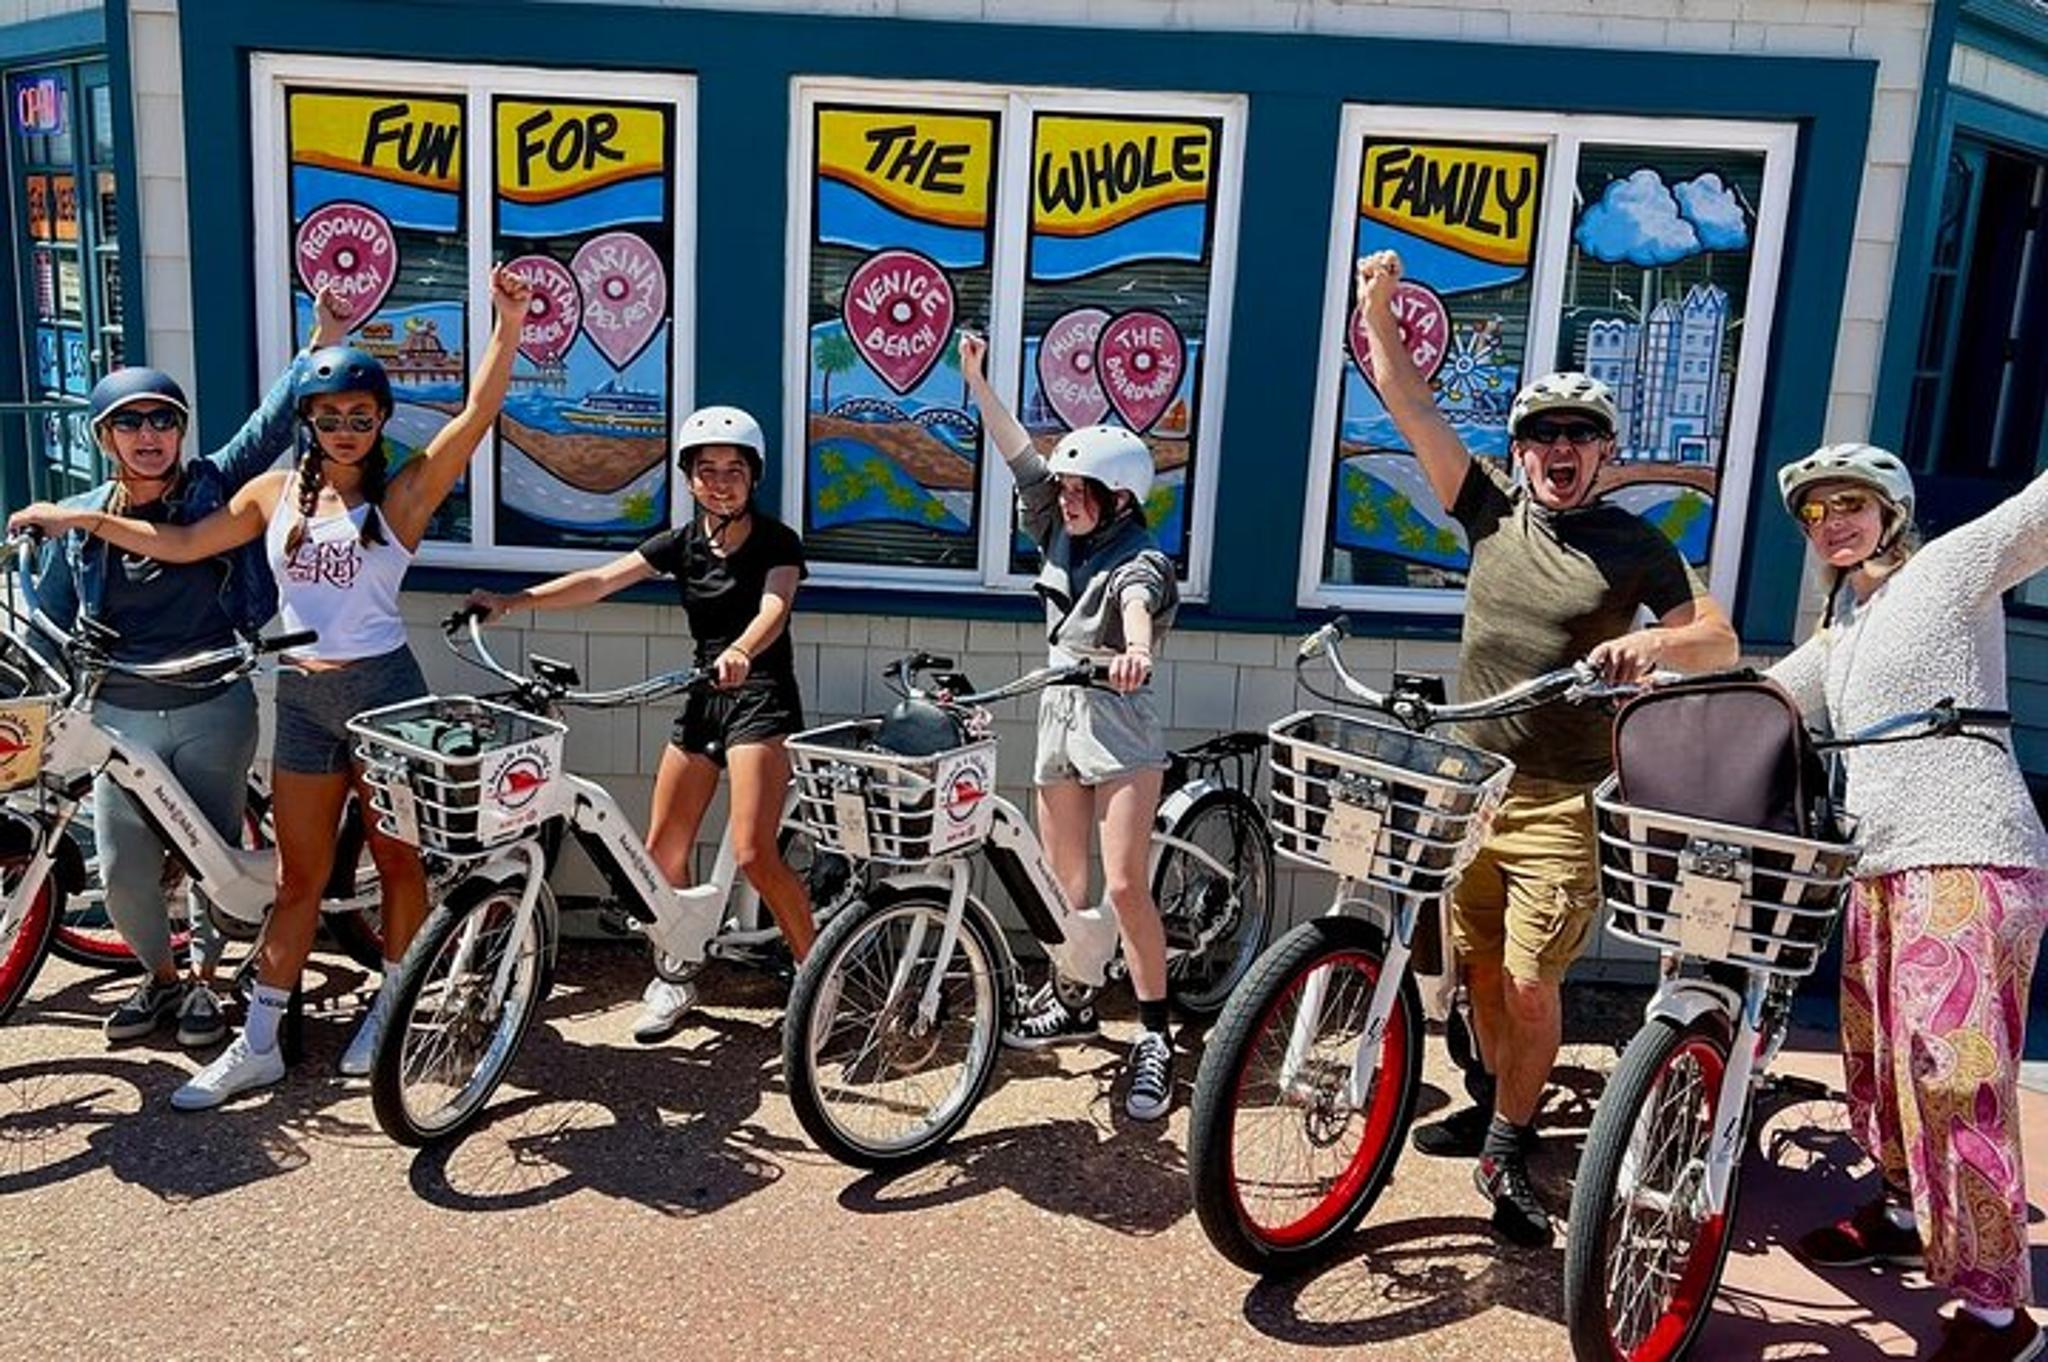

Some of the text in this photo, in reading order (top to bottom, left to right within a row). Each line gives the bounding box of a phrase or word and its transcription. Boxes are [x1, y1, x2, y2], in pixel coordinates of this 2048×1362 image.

[361, 103, 1532, 239] FUN FOR THE WHOLE FAMILY
[301, 217, 388, 259] REDONDO
[313, 264, 382, 294] BEACH
[577, 245, 657, 294] MARINA
[855, 269, 946, 317] VENICE
[520, 320, 565, 345] EACH
[585, 300, 622, 330] DEL
[864, 323, 937, 357] BEACH
[1050, 323, 1101, 360] MUSC
[1115, 326, 1164, 349] THE
[1054, 376, 1101, 405] BEAC
[1106, 354, 1176, 401] BOARDWALK
